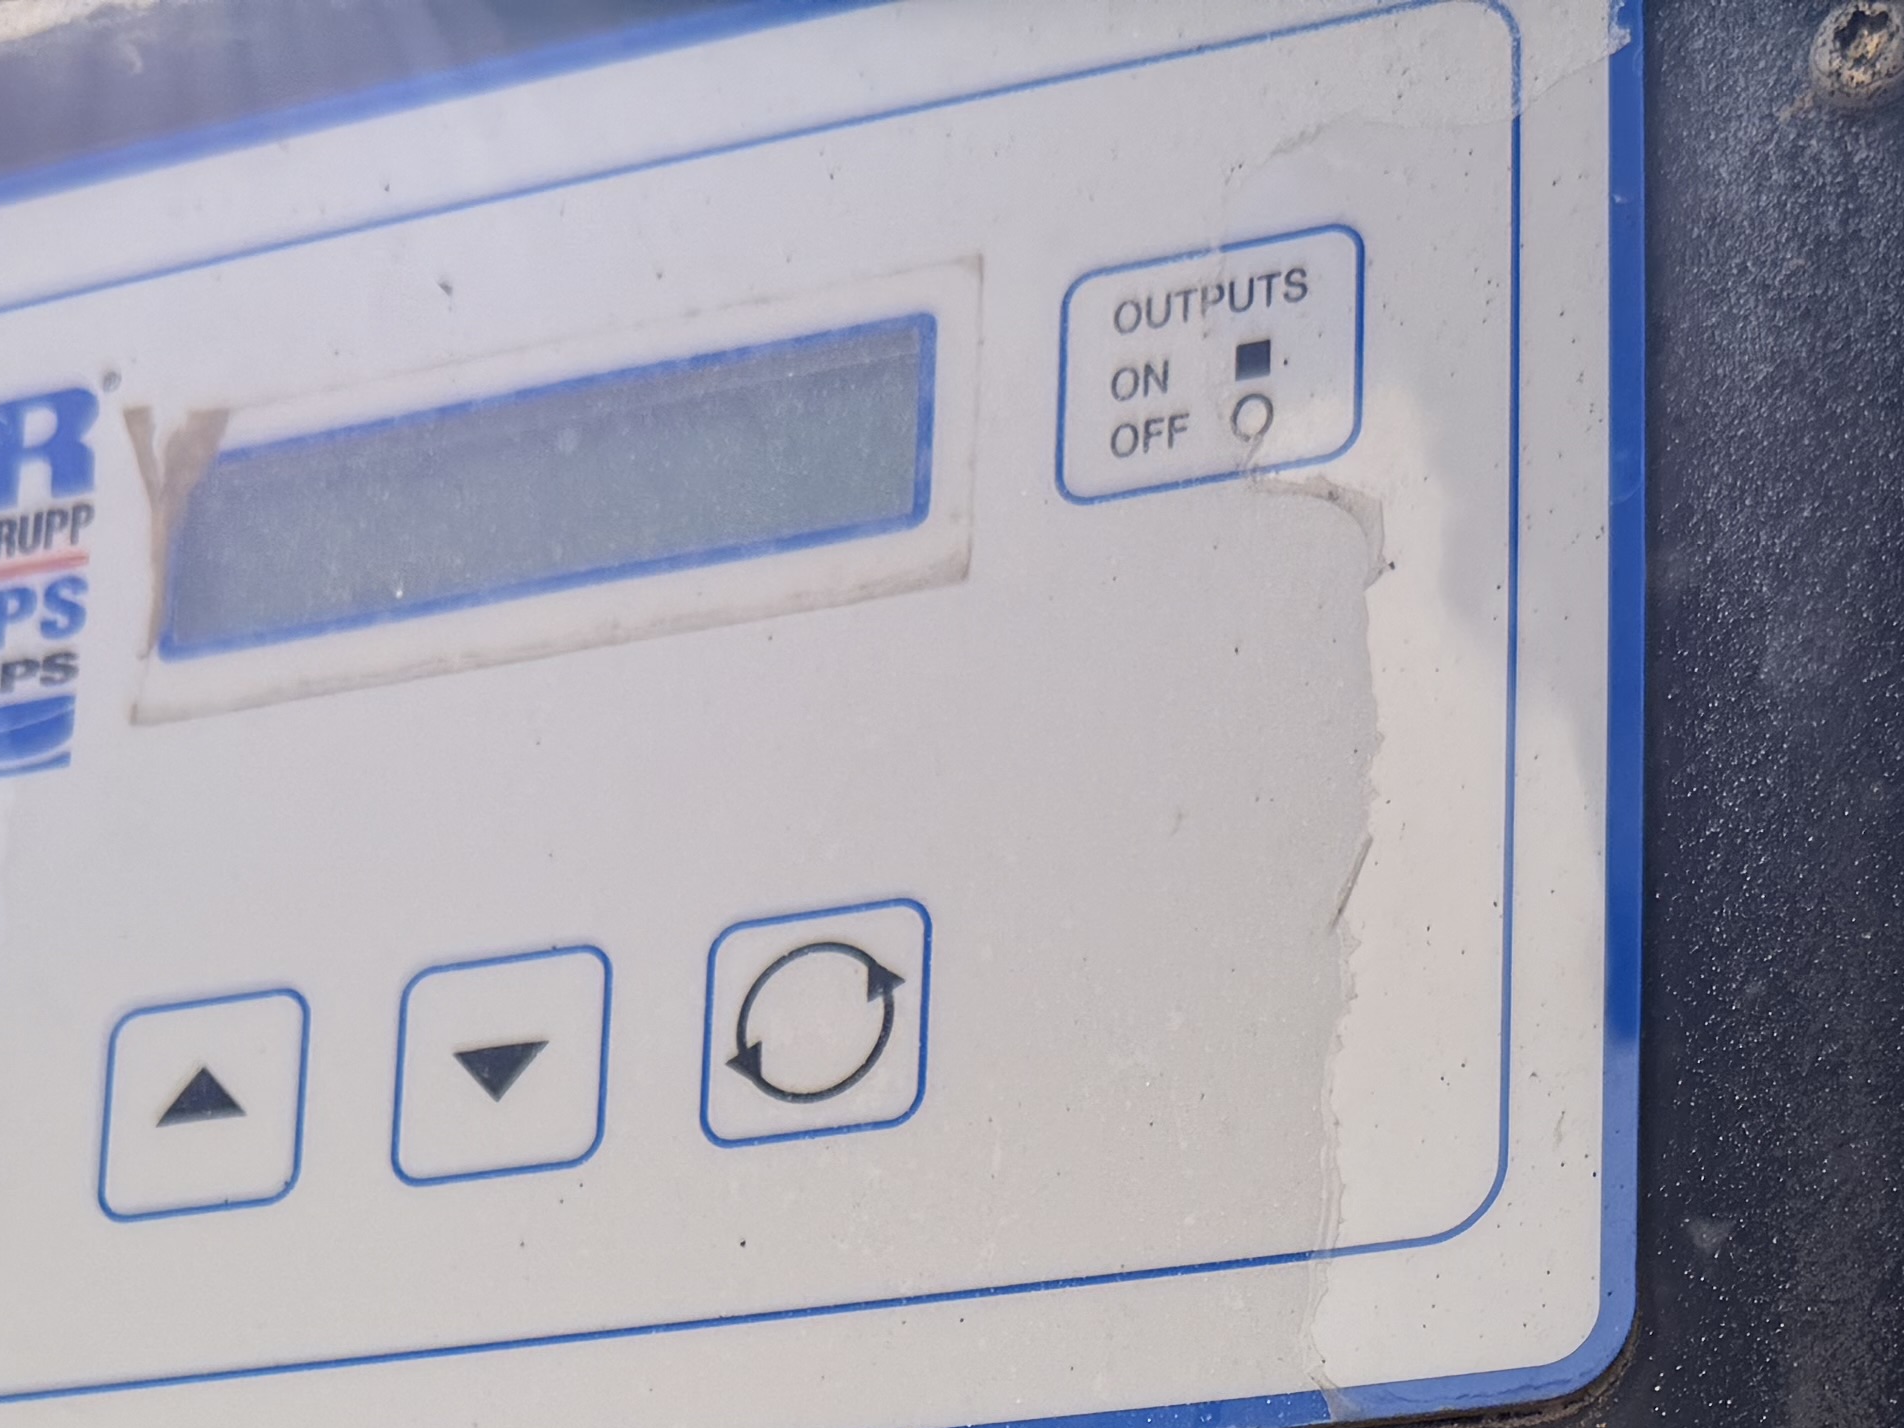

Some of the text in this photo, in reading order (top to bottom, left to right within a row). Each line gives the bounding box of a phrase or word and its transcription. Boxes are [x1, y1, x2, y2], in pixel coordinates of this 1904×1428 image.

[1113, 267, 1309, 335] OUTPUTS
[1111, 359, 1170, 402] ON
[1110, 413, 1190, 459] OFF
